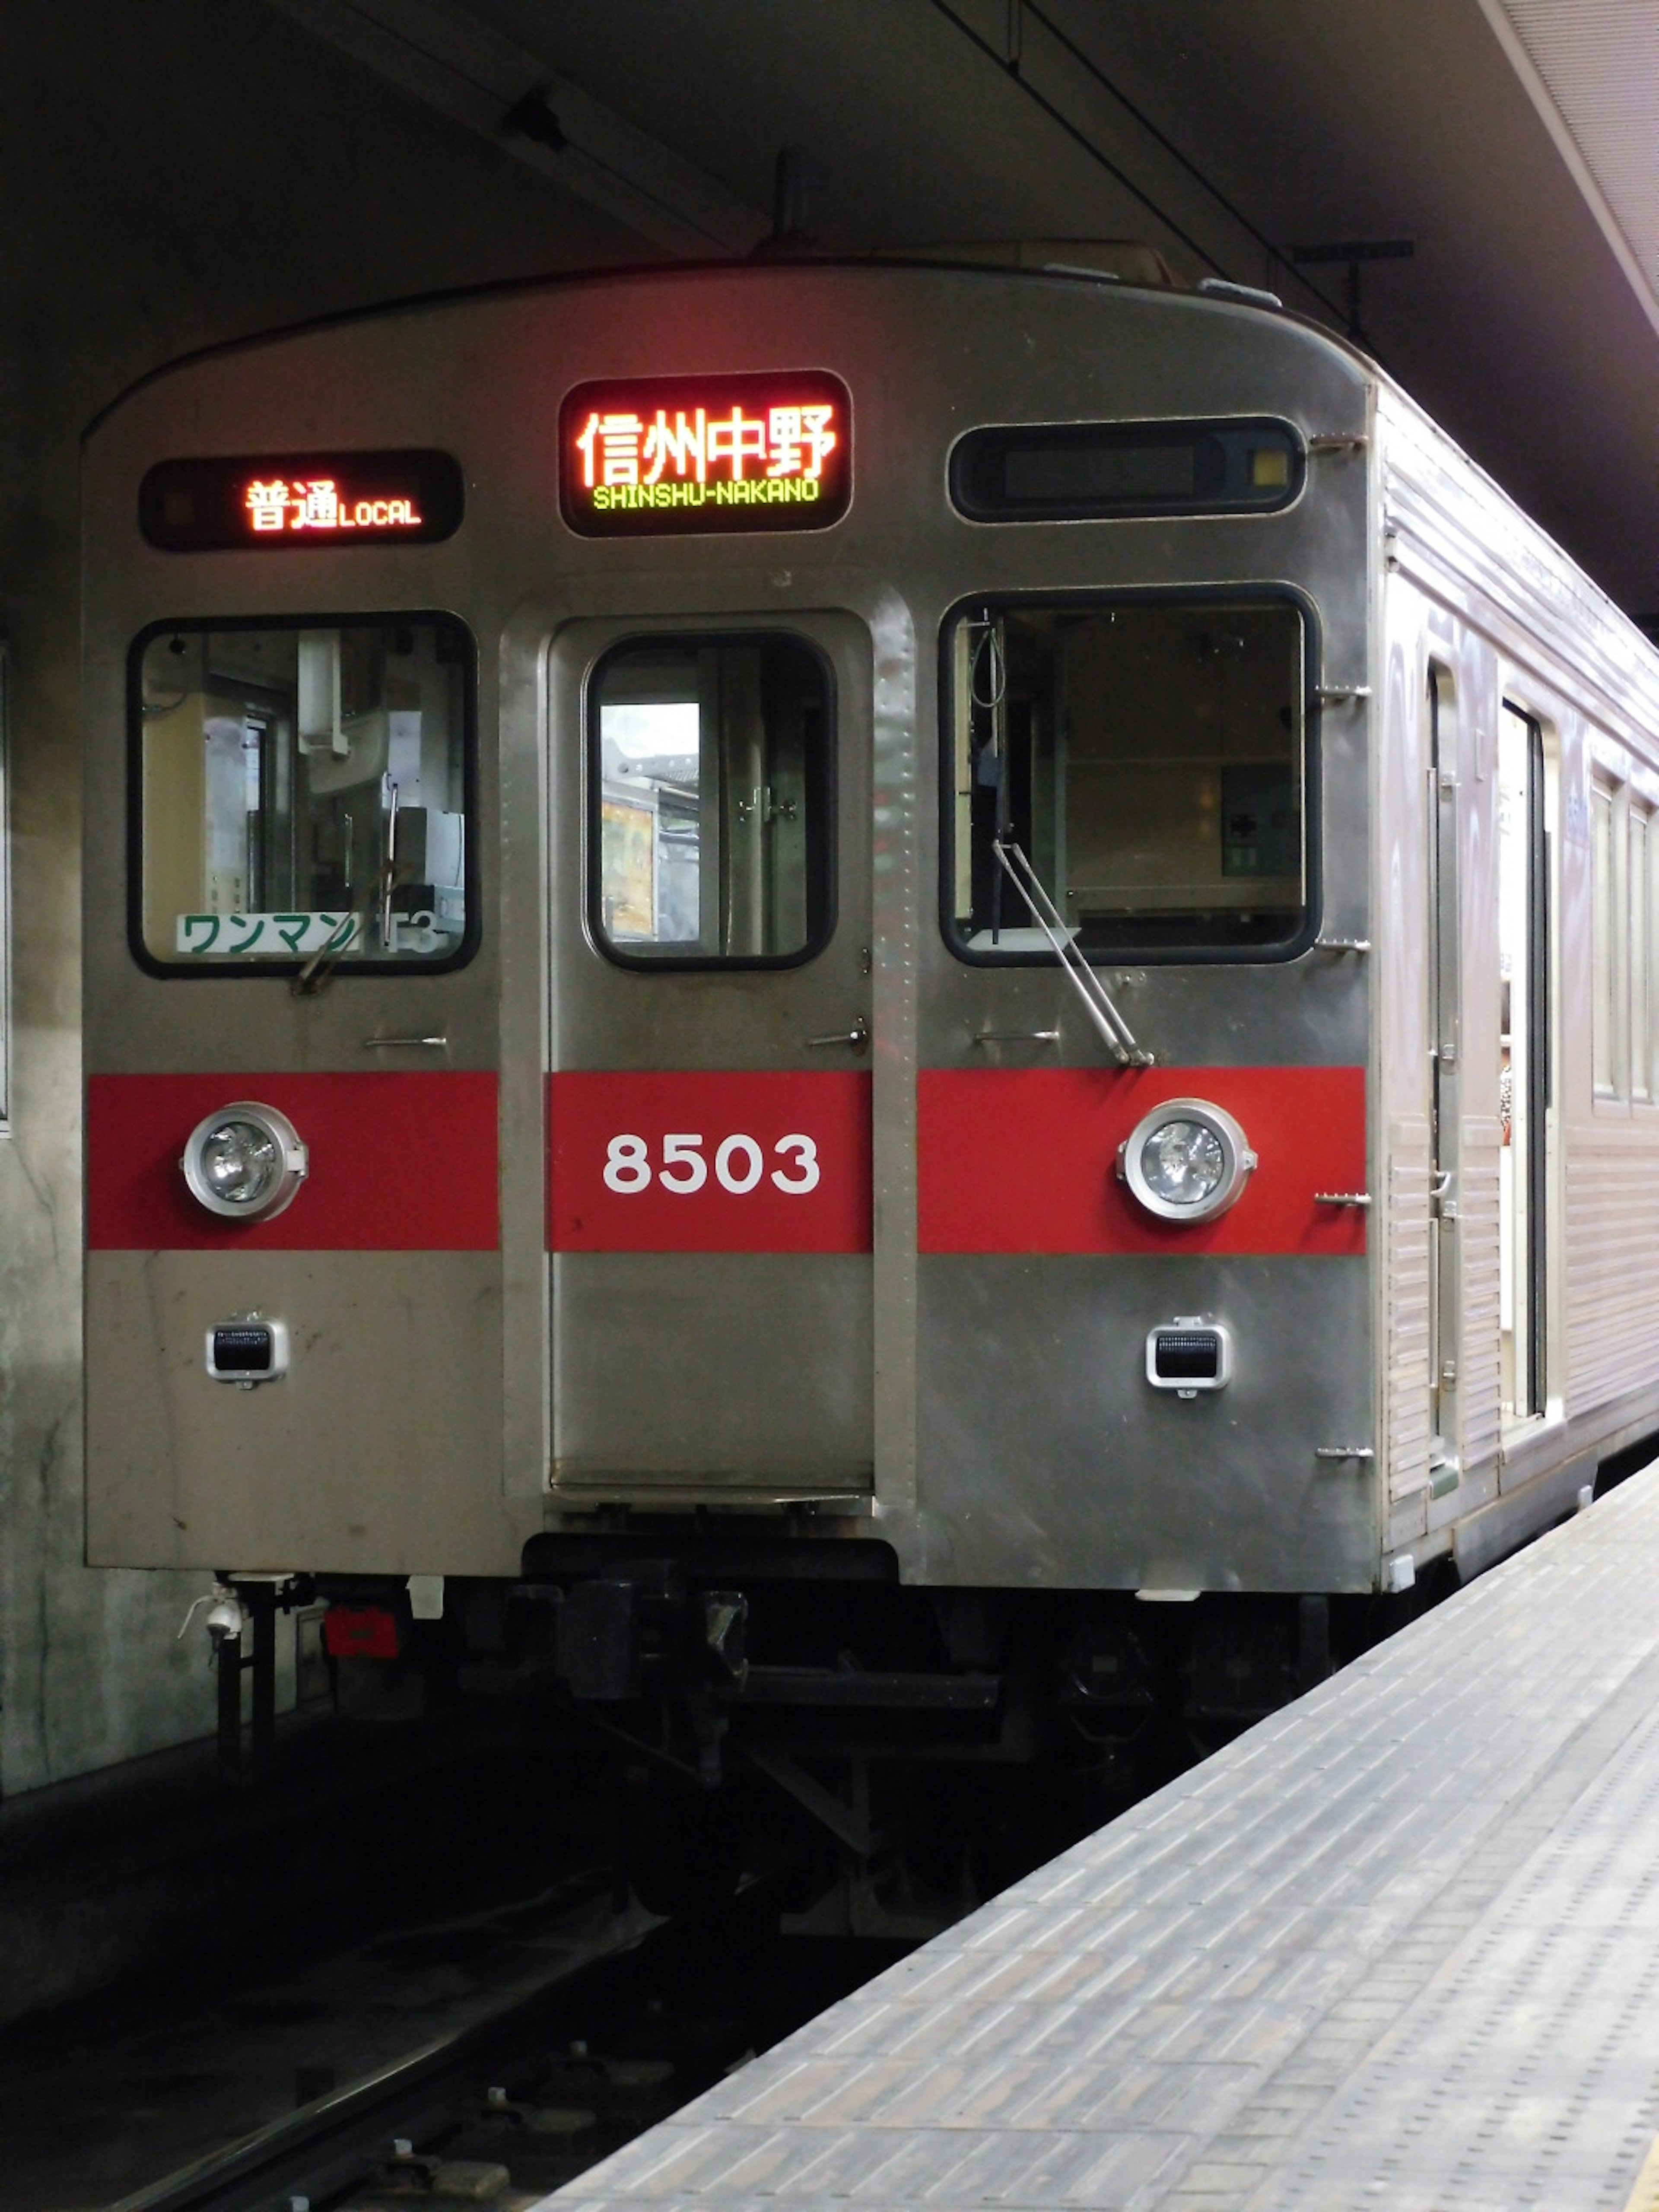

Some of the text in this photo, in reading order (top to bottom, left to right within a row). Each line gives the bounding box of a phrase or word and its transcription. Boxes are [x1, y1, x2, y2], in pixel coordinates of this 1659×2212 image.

[576, 406, 836, 487] 信州中野
[245, 480, 422, 531] 普通 LOCAL
[594, 478, 820, 509] SHINSHU-NAKANO
[185, 915, 355, 953] ワンマン
[375, 910, 437, 953] T3
[603, 1134, 820, 1194] 8503
